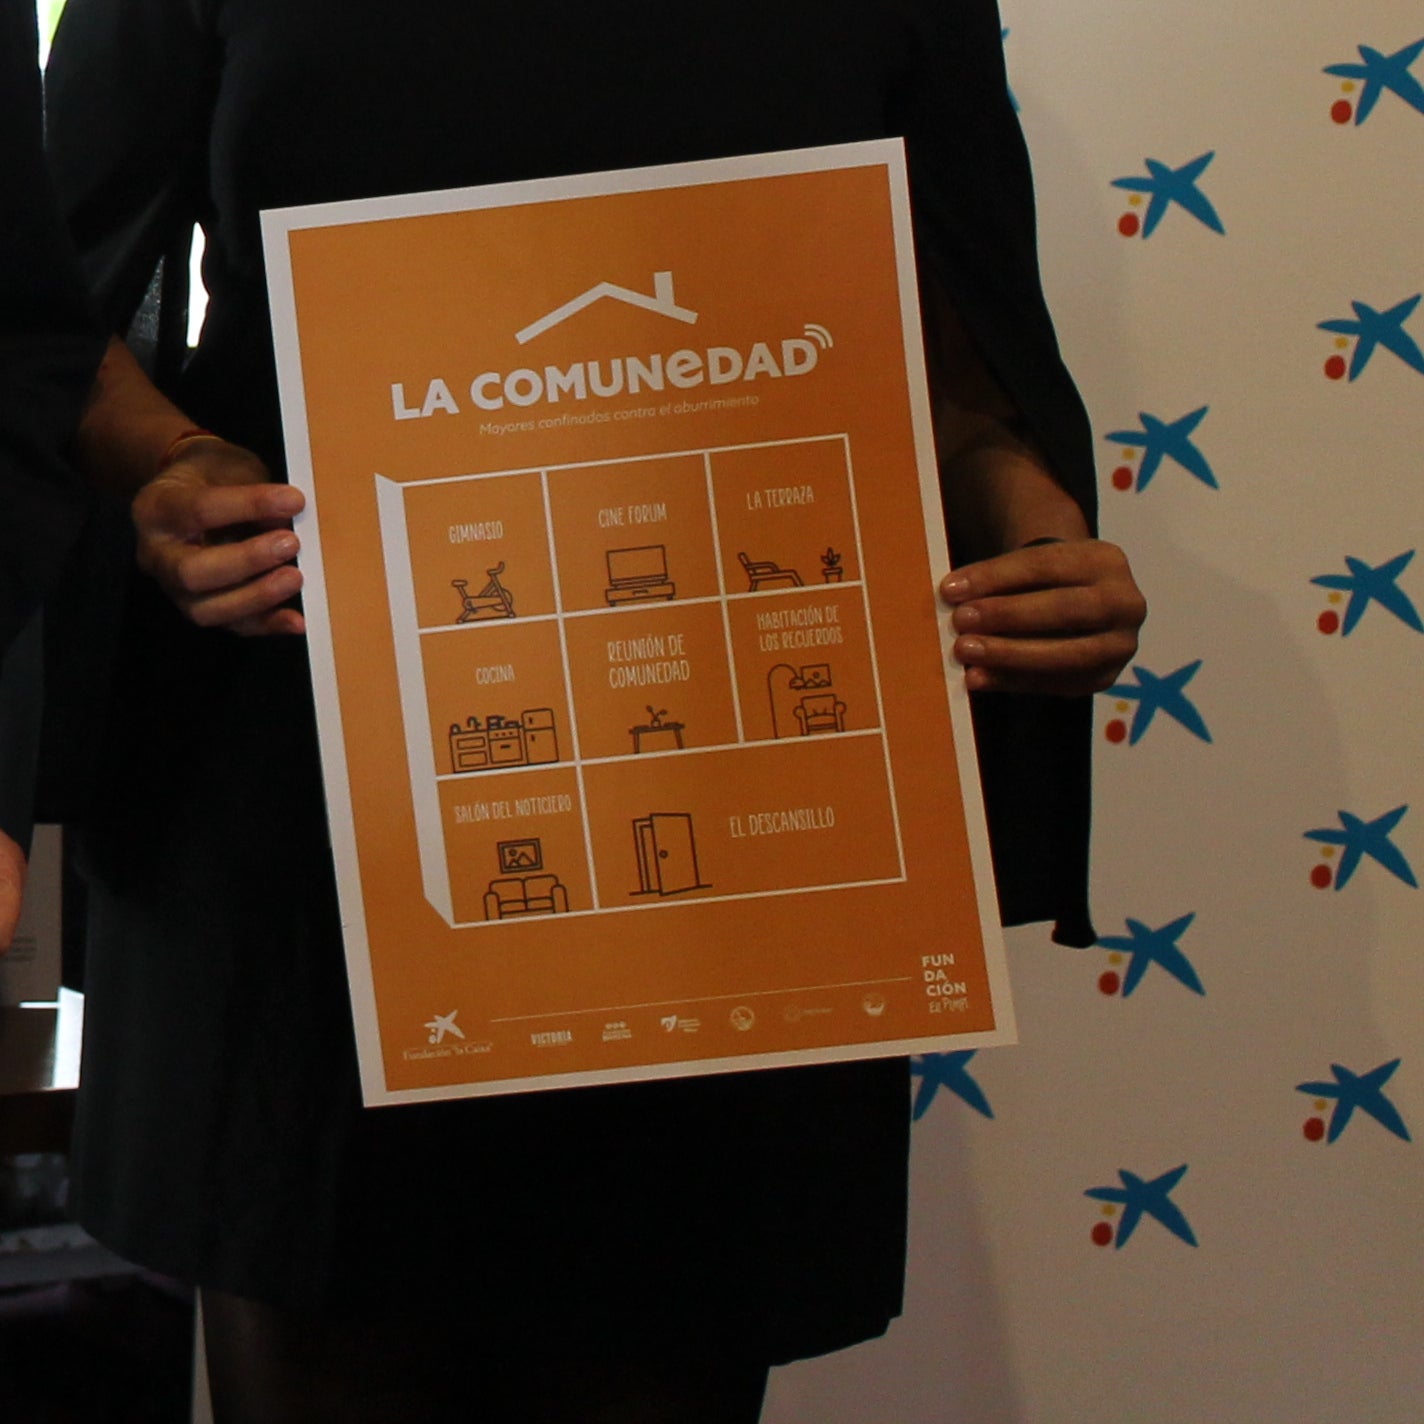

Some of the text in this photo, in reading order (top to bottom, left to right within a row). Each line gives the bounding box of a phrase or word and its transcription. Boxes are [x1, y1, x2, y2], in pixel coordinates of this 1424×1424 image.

[392, 377, 459, 420] LA
[480, 396, 759, 435] Mayores confinados contra el aburrimiento
[747, 486, 814, 510] LA TERRAZA
[598, 503, 666, 527] CINE FORUM
[449, 521, 503, 543] GIMNASIO
[756, 605, 840, 631] HABITACIÓN DE
[608, 634, 685, 664] REUNIÓN DE
[759, 626, 844, 652] LOS RECUERDOS
[476, 664, 515, 684] COCINA
[609, 660, 689, 688] COMUNEDAD
[454, 795, 571, 823] SALÓN DEL NOTICIERO
[730, 807, 834, 837] EL DESCANSILLO
[922, 954, 954, 967] FUN
[924, 969, 947, 982] DA
[925, 981, 966, 996] CIÓN
[531, 1031, 572, 1044] VICTORIA
